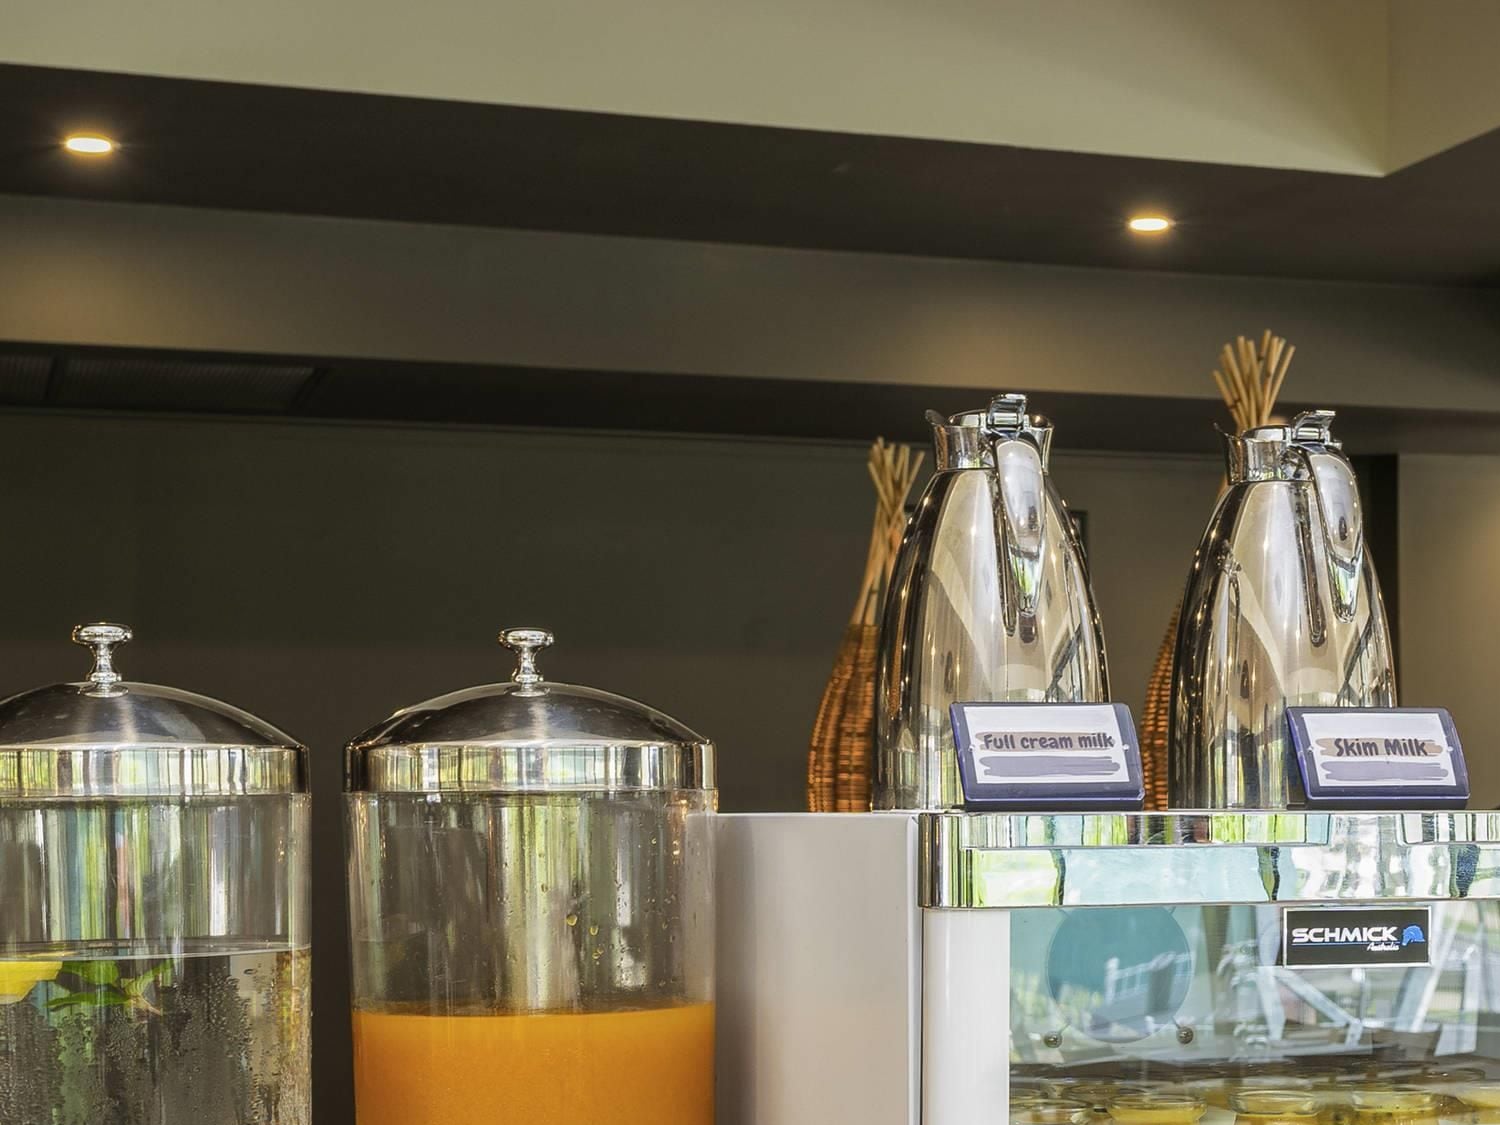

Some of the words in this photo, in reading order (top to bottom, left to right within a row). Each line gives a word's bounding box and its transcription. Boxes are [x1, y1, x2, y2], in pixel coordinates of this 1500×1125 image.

[983, 734, 1015, 749] Full
[1021, 736, 1073, 749] cream
[1078, 732, 1114, 748] milk
[1334, 738, 1379, 757] Skim
[1384, 738, 1428, 756] Milk
[1291, 926, 1398, 943] SCHMICK
[1367, 942, 1400, 952] Australia
